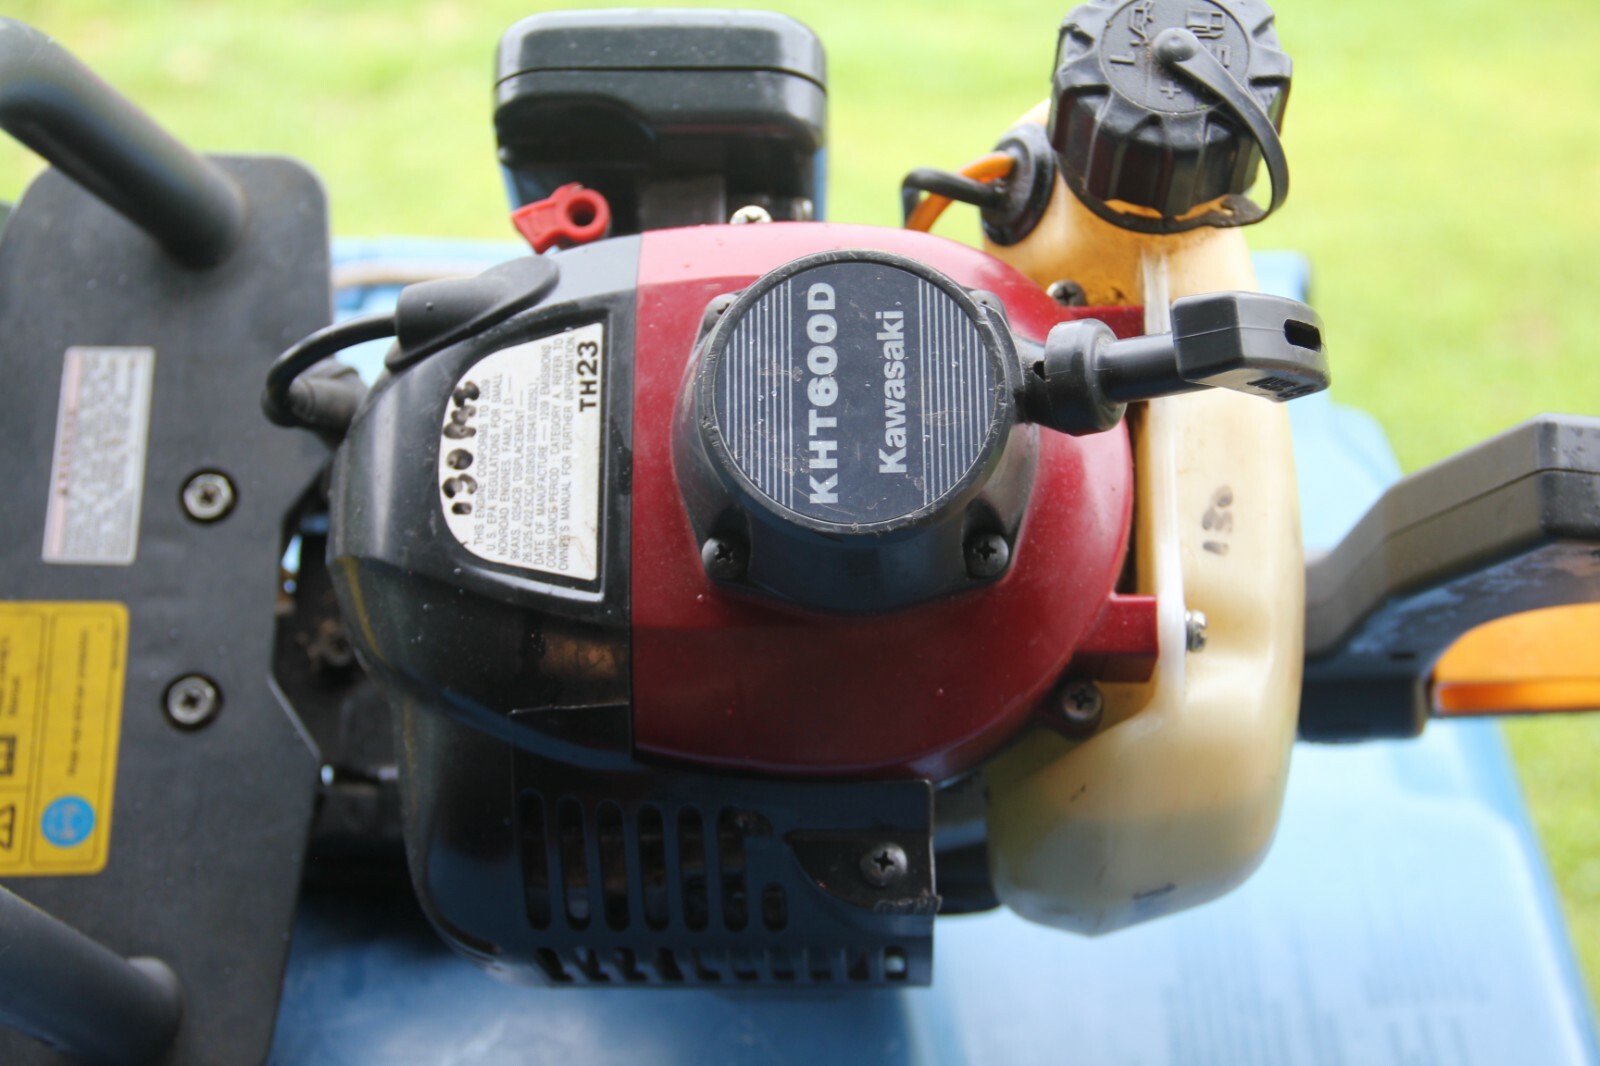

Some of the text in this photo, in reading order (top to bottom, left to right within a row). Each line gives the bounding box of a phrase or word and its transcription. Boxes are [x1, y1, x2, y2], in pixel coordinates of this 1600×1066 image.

[554, 338, 563, 350] TO
[541, 345, 551, 395] EMISSIONS
[553, 356, 562, 385] REFER
[577, 341, 598, 412] TH23
[492, 373, 502, 403] SMALL
[807, 282, 839, 504] KHT600D
[876, 310, 907, 474] Kawasaki
[479, 405, 488, 418] TO
[491, 409, 500, 428] FOR
[562, 406, 573, 450] FURTHER
[477, 424, 488, 477] CONFORMS
[502, 419, 512, 452] FAMILY
[513, 410, 524, 481] DISPLACEMENT
[488, 433, 500, 500] REGULATIONS
[536, 445, 548, 516] MANUFACTURE
[562, 455, 572, 475] FOR
[475, 483, 485, 518] ENGINE
[549, 467, 559, 502] PERIOD
[561, 481, 571, 520] MANUAL
[487, 506, 496, 524] EPA
[498, 508, 509, 556] NONROAD
[535, 522, 545, 534] OF
[474, 524, 484, 545] THIS
[546, 507, 557, 567] COMPLIANCE
[534, 540, 544, 565] DATE
